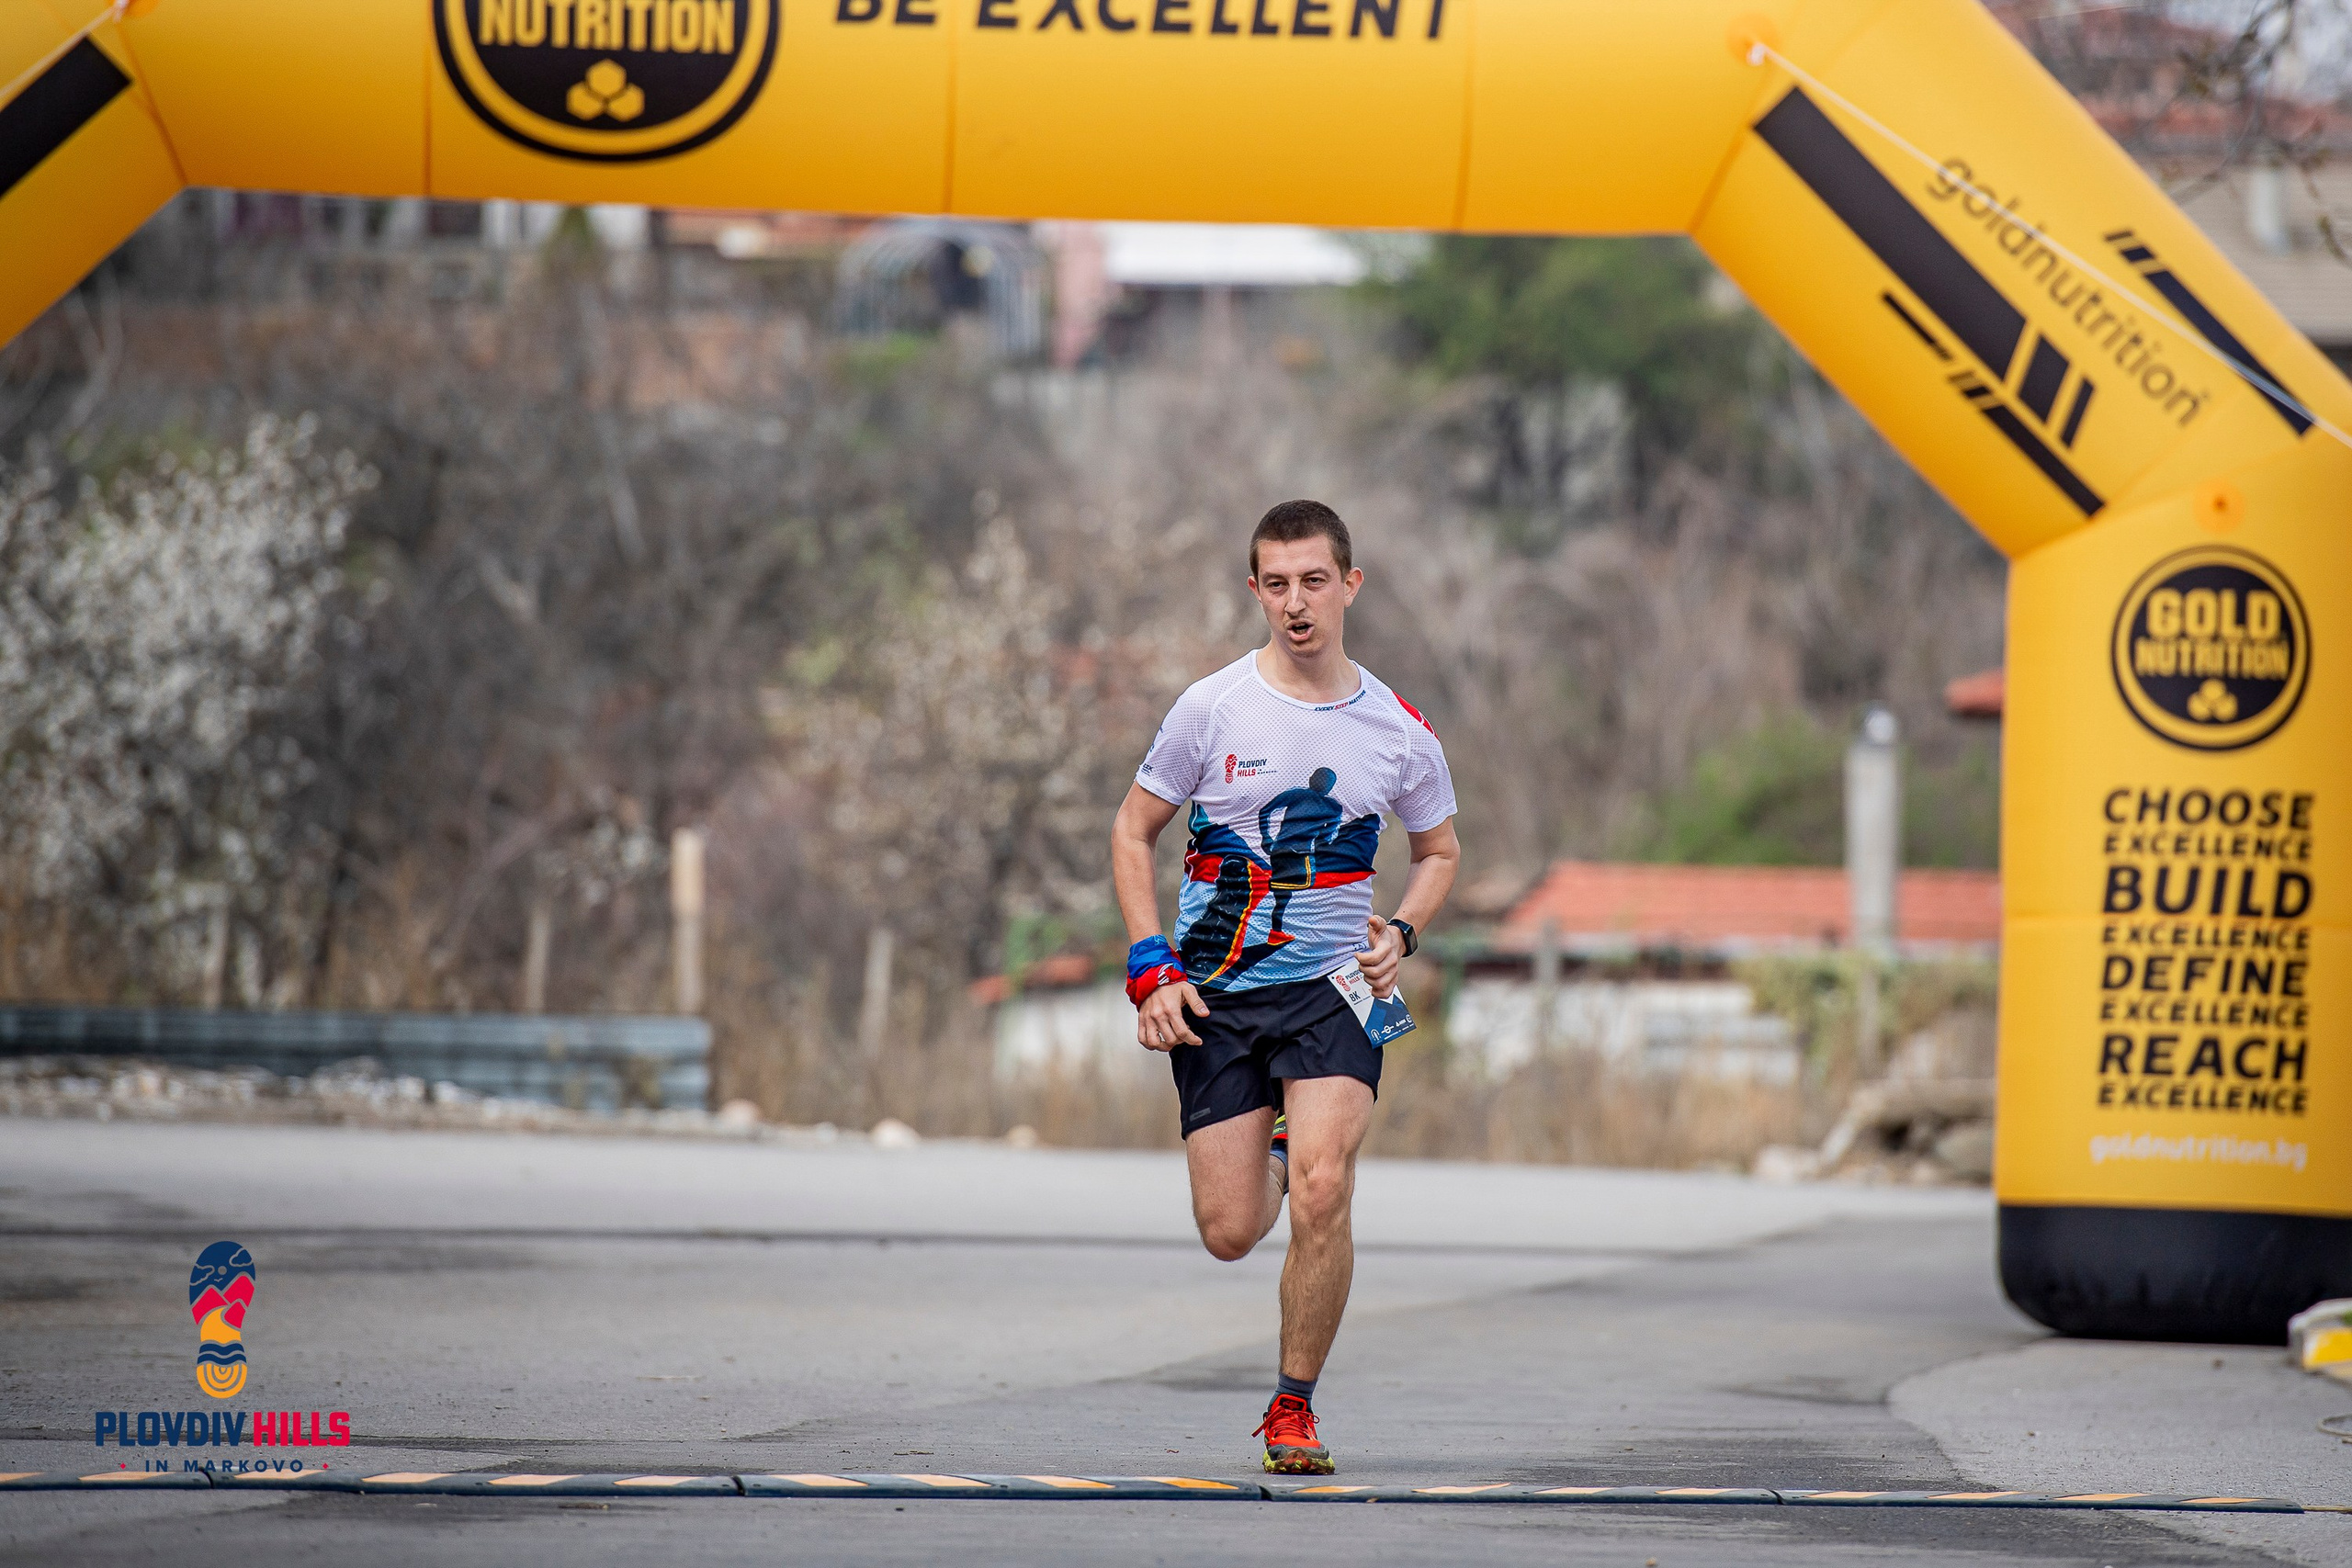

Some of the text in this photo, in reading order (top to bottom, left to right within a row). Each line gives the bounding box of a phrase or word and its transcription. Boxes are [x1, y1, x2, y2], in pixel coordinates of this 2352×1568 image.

[478, 0, 735, 54] NUTRITION
[1926, 156, 2203, 428] goldnutrition
[2146, 587, 2282, 640] GOLD
[2133, 636, 2290, 681] NUTRITION
[1237, 768, 1257, 777] HILLS
[1238, 758, 1268, 769] PLOVDIV
[2104, 789, 2314, 829] CHOOSE
[2104, 835, 2313, 862] EXCELLENCE
[2101, 865, 2314, 919] BUILD
[2102, 925, 2311, 951] EXCELLENCE
[2100, 954, 2310, 998] DEFINE
[1349, 991, 1361, 1002] 8K
[2100, 1000, 2309, 1028] EXCELLENCE
[2098, 1033, 2309, 1081] REACH
[2098, 1084, 2309, 1114] EXCELLENCE
